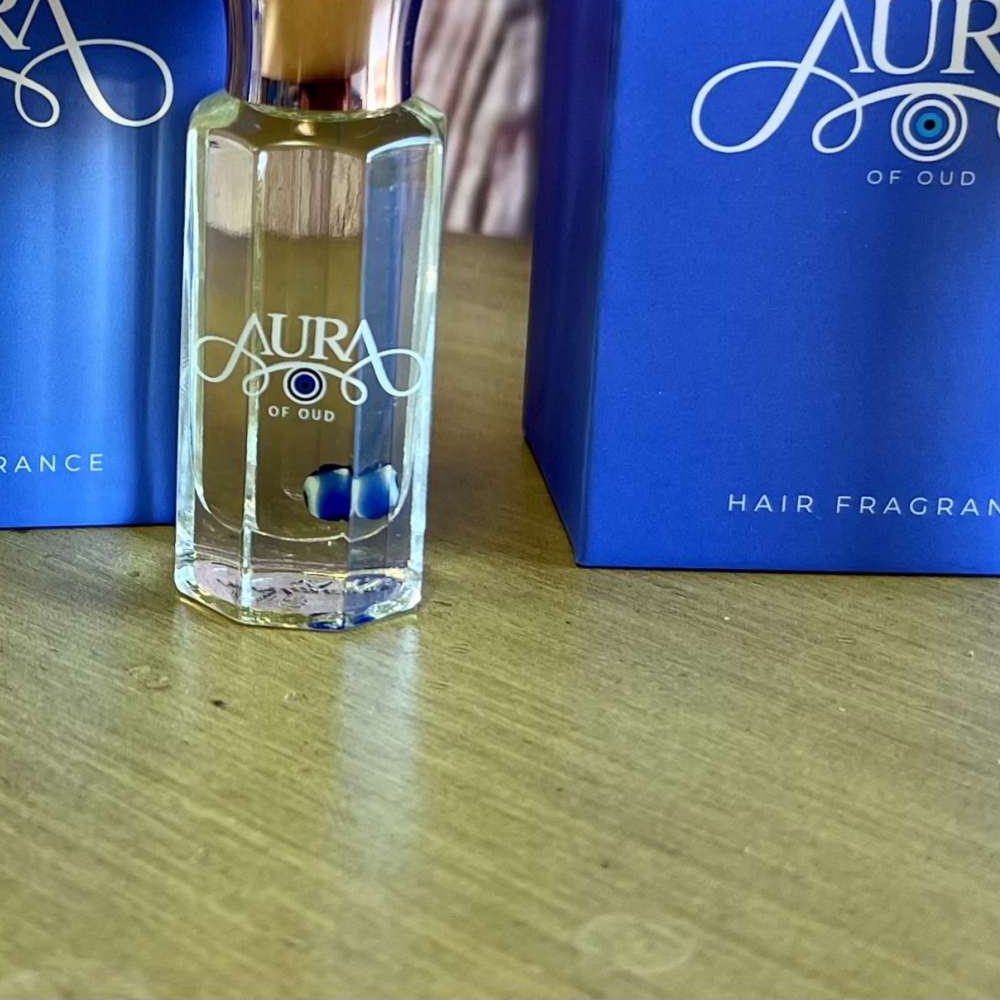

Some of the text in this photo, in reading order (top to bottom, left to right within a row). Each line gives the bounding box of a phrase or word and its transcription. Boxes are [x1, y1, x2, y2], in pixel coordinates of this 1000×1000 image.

[866, 170, 976, 186] OF OUD
[268, 405, 336, 422] OF OUD
[728, 494, 814, 513] HAIR
